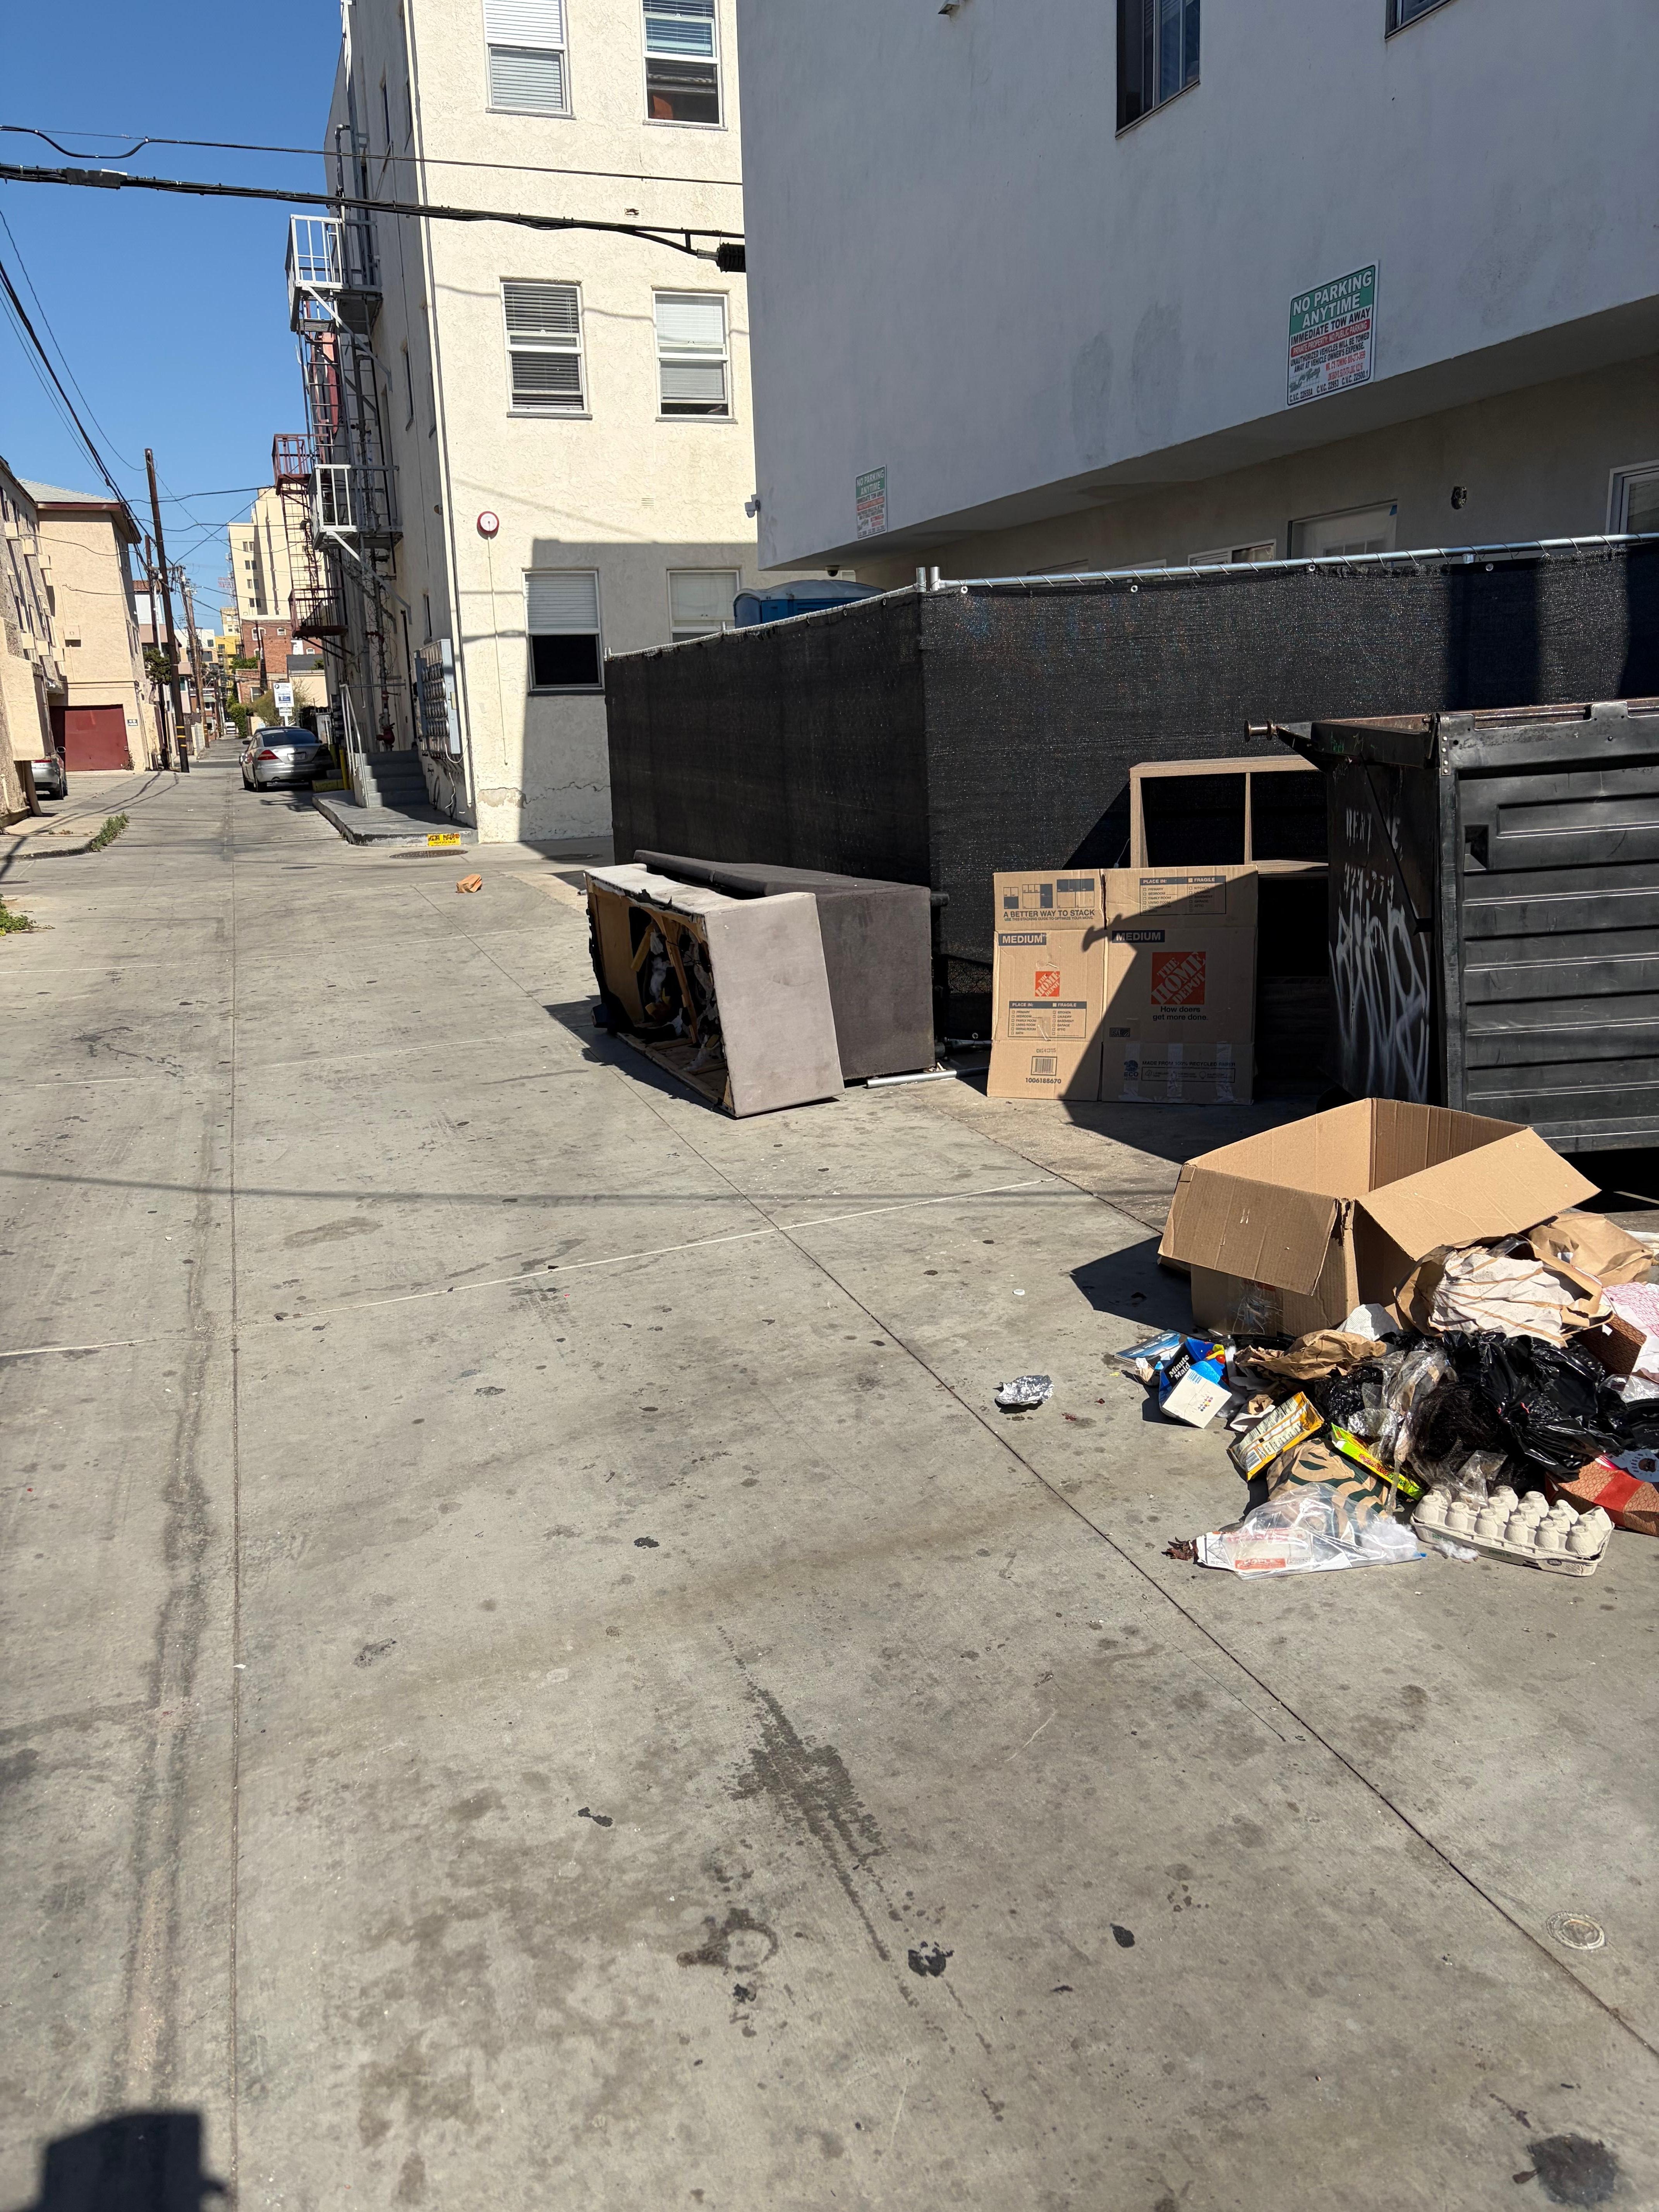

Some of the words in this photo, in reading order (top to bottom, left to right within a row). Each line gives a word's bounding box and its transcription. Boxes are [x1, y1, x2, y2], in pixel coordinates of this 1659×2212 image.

[1293, 295, 1310, 316] NO
[1314, 270, 1372, 308] PARKING
[1302, 292, 1360, 329] ANYTIME
[1291, 323, 1328, 346] IMMEDIATE
[1331, 315, 1348, 331] TOW
[1349, 307, 1370, 324] AWAY
[1290, 350, 1318, 366] UNAUTHORIZED
[1320, 343, 1338, 356] VEHICLES
[1339, 339, 1348, 349] WILL
[1349, 337, 1354, 346] BE
[1355, 331, 1369, 343] TOWED
[1293, 343, 1308, 356] PRIVATE
[1329, 333, 1334, 342] NO
[1335, 327, 1349, 340] PUBLIC
[1349, 321, 1367, 335] PARKING
[1294, 363, 1304, 373] AWAY
[1311, 355, 1326, 367] VEHICLE
[1328, 349, 1345, 361] OWNER'S
[1316, 383, 1327, 393] C.V.C.
[1341, 374, 1353, 385] C.V.C.
[857, 477, 863, 487] NO
[864, 469, 884, 484] PARKING
[860, 481, 880, 496] ANYTIME
[1002, 935, 1042, 943] MEDIUM
[1116, 932, 1161, 941] MEDIUM
[1038, 973, 1047, 984] THE
[1151, 952, 1206, 1005] HOME
[1157, 957, 1180, 979] THE
[1035, 971, 1060, 996] HOME
[1045, 981, 1060, 996] DEPOT
[1171, 971, 1206, 1005] DEPOT
[1169, 1355, 1189, 1378] Minute
[1175, 1362, 1190, 1380] Maid
[1388, 1472, 1406, 1487] SOR
